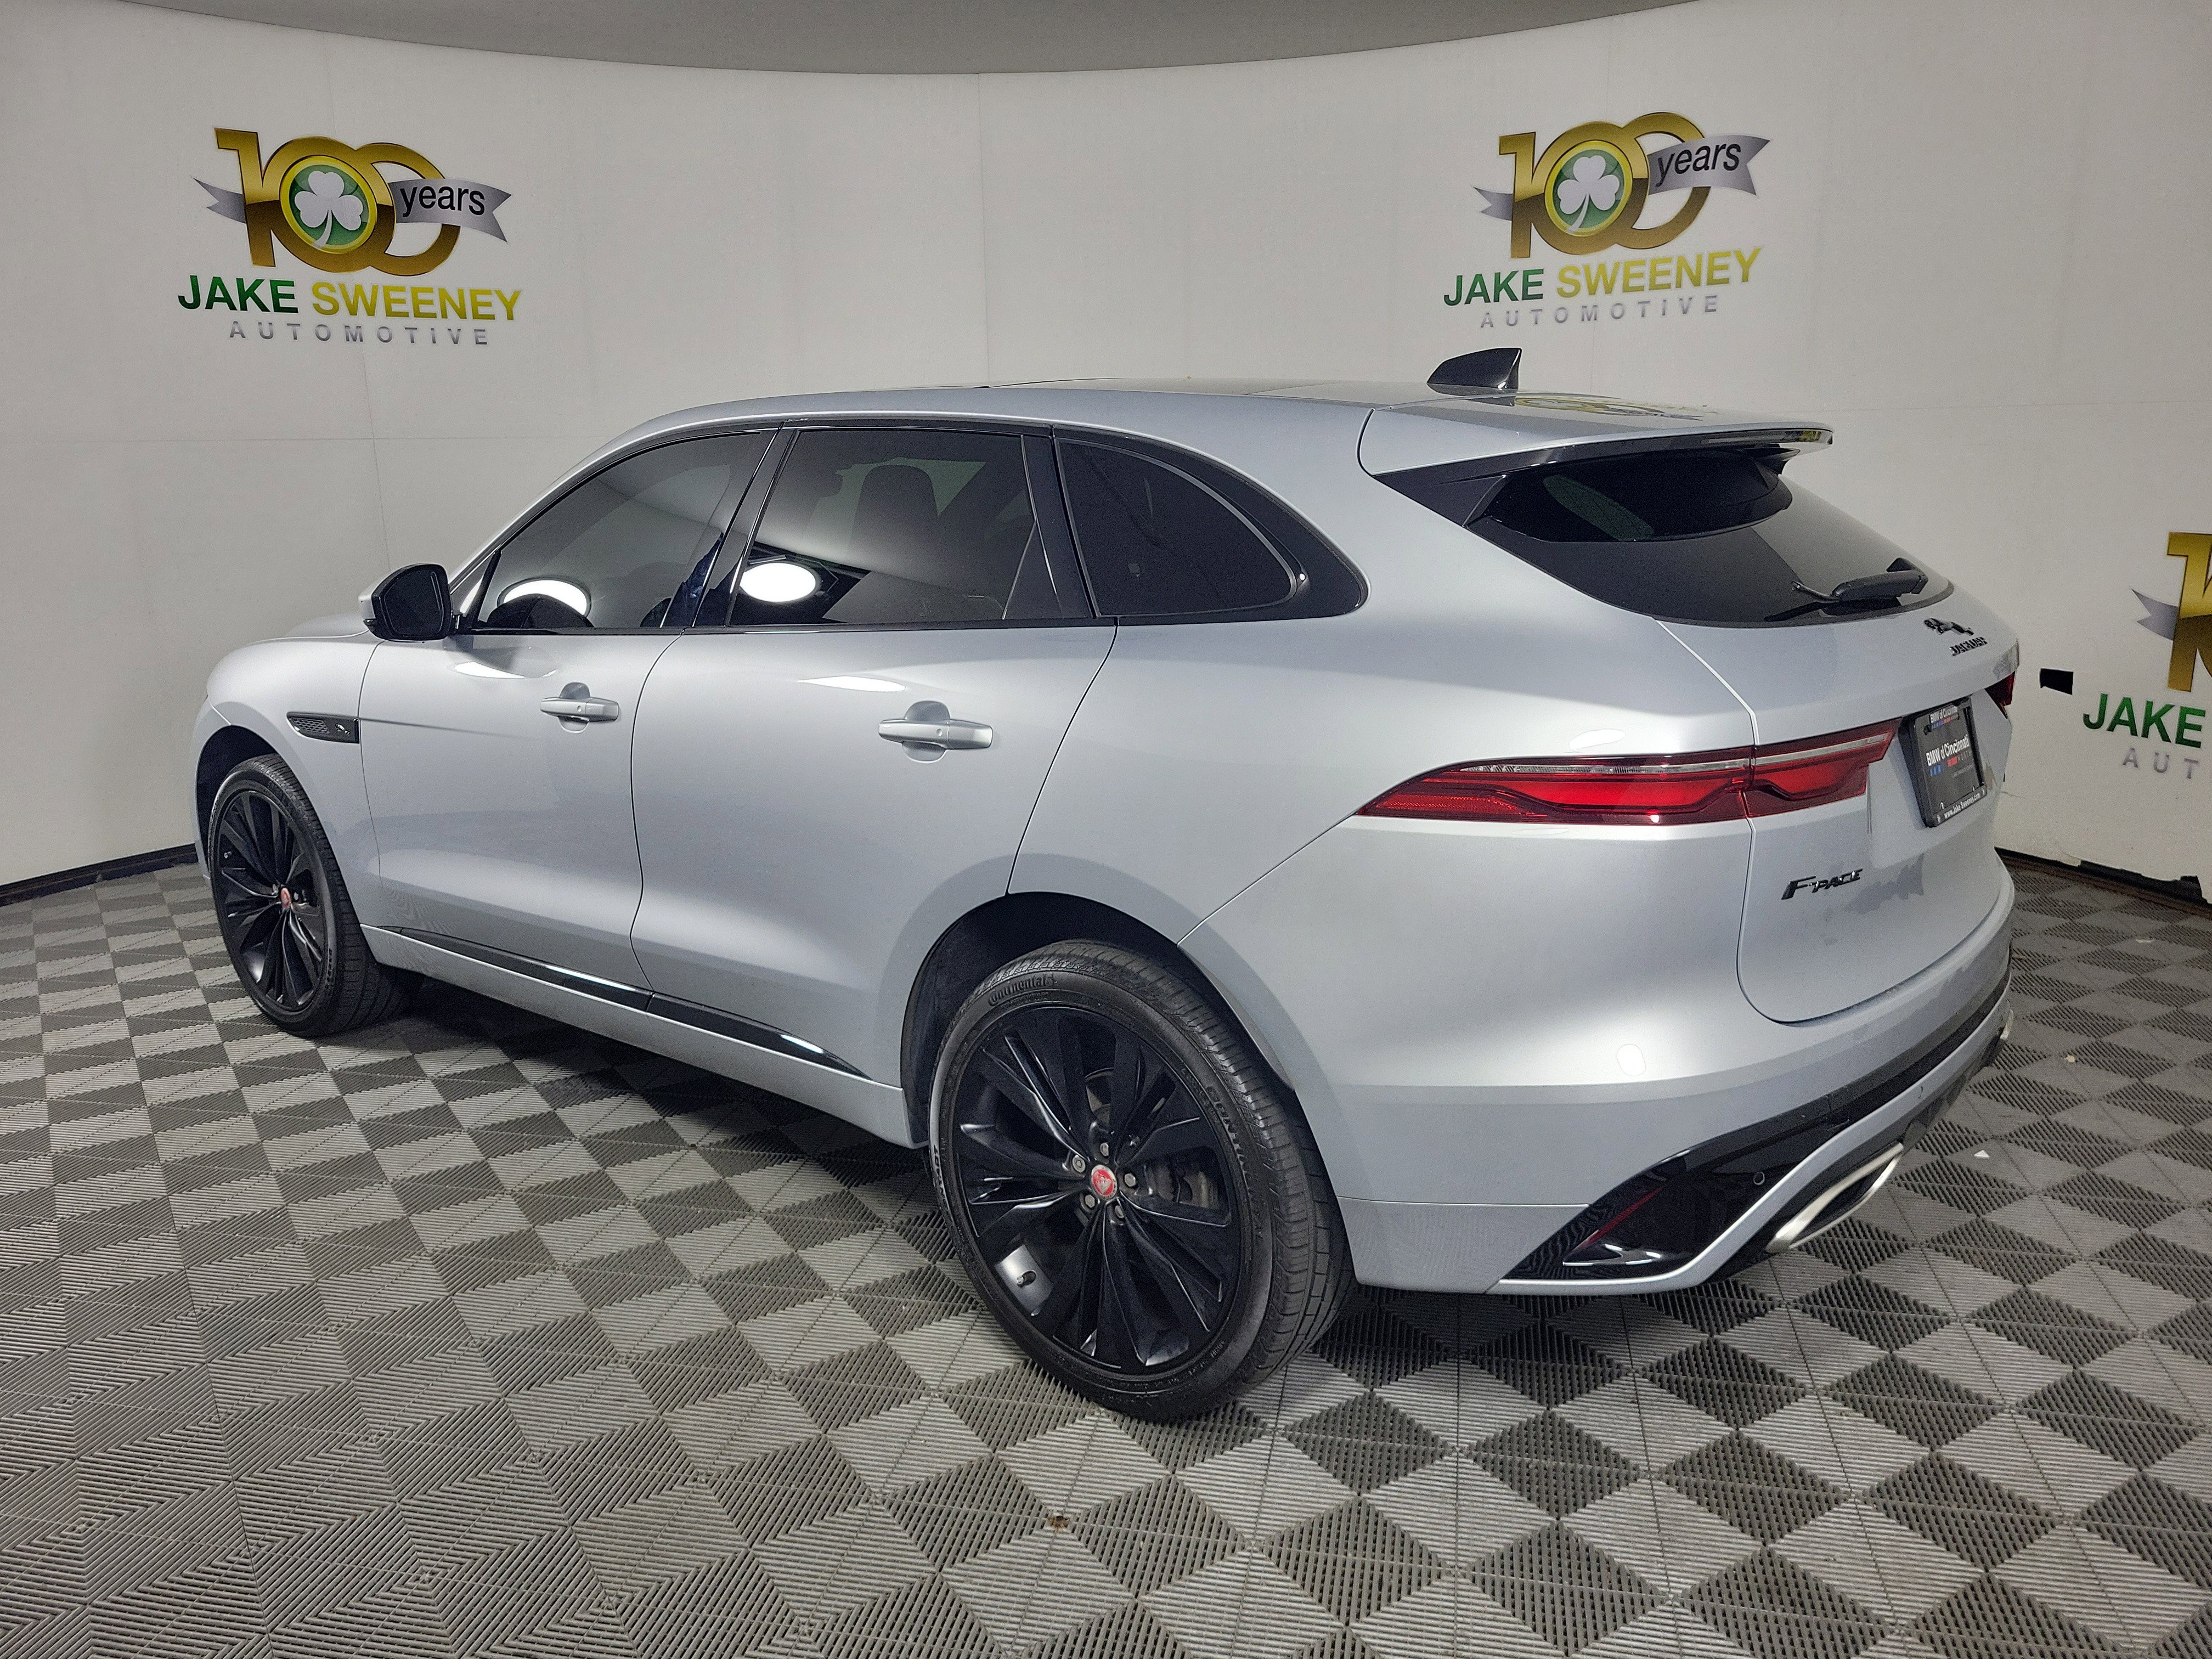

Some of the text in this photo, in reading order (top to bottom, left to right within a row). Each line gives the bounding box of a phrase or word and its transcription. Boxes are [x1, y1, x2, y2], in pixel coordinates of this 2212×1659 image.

[1655, 142, 1741, 187] years
[400, 184, 486, 218] years
[1443, 247, 1761, 306] JAKE SWEENEY
[178, 275, 523, 321] JAKE SWEENEY
[1480, 295, 1718, 328] AUTOMOTIVE
[229, 321, 488, 346] AUTOMOTIVE
[1949, 636, 1988, 656] JAGUAR
[2083, 693, 2206, 748] JAKE
[1926, 748, 1941, 766] BMW
[1944, 734, 1970, 757] Cincinnati
